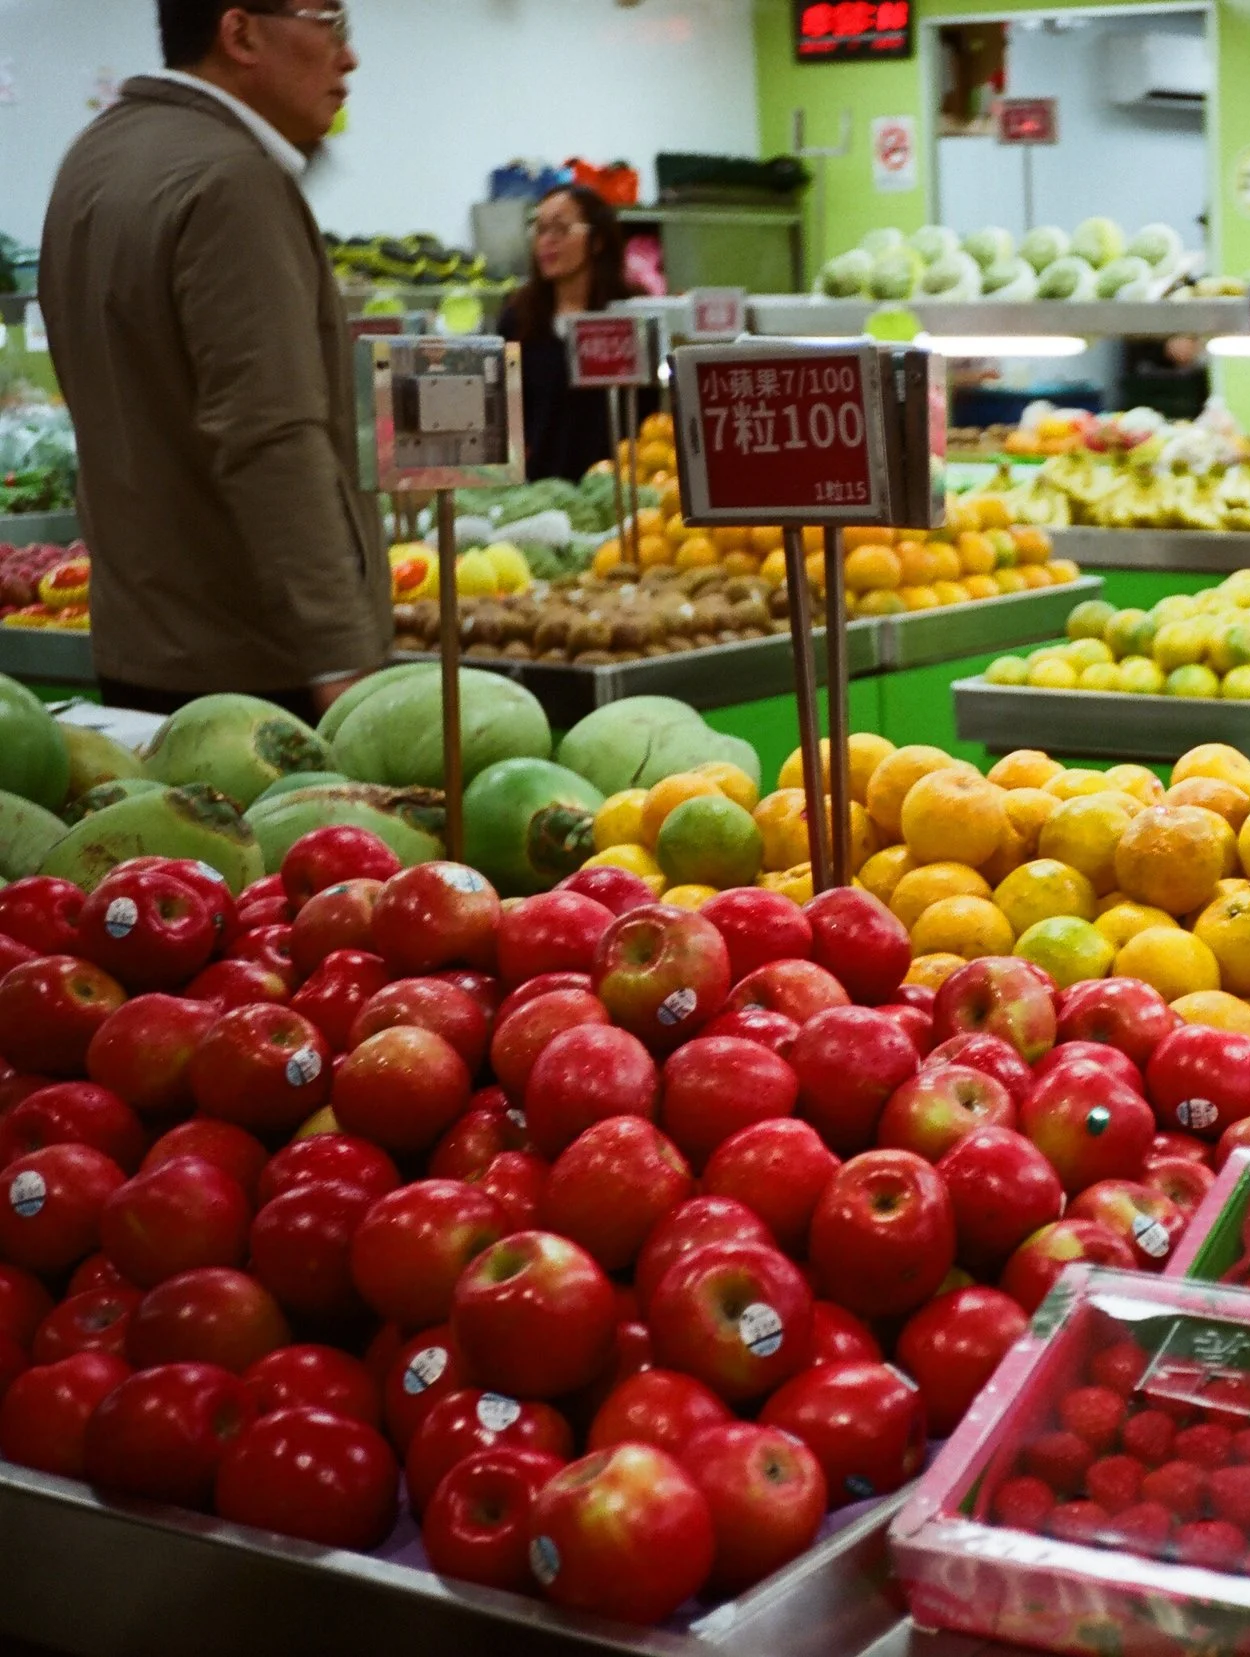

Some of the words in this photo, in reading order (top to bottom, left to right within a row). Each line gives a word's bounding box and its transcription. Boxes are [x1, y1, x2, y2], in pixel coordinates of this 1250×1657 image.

[702, 365, 856, 400] 小蘋果7/100
[704, 401, 865, 455] 7粒100
